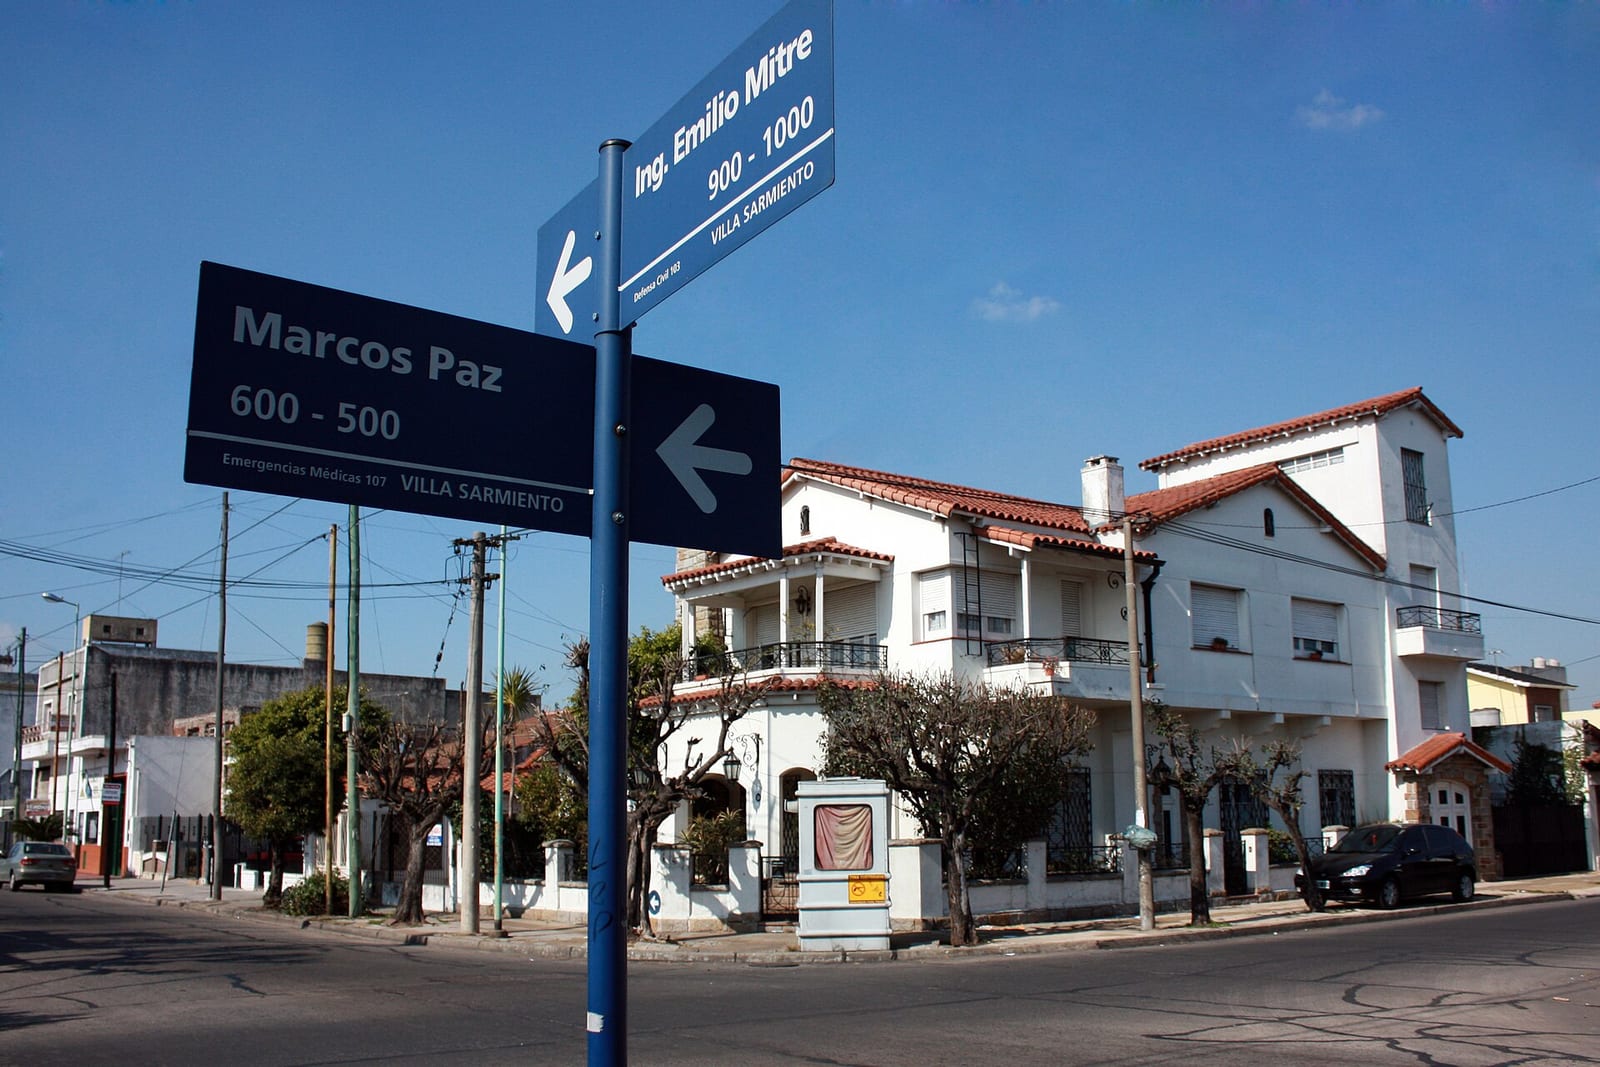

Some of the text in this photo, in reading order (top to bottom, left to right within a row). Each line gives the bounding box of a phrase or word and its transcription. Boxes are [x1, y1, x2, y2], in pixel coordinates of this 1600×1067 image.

[635, 28, 813, 198] Ing. Emilio Mitre
[708, 151, 742, 201] 900
[762, 95, 814, 157] 1000
[711, 161, 814, 245] VILLA SARMIENTO
[633, 260, 681, 303] Defensa Civil 103
[233, 305, 503, 393] Marcos Paz
[230, 384, 299, 424] 600
[337, 402, 400, 440] 500
[223, 453, 387, 487] Emergencias Médicas 107
[401, 474, 564, 513] VILLA SARMIENTO
